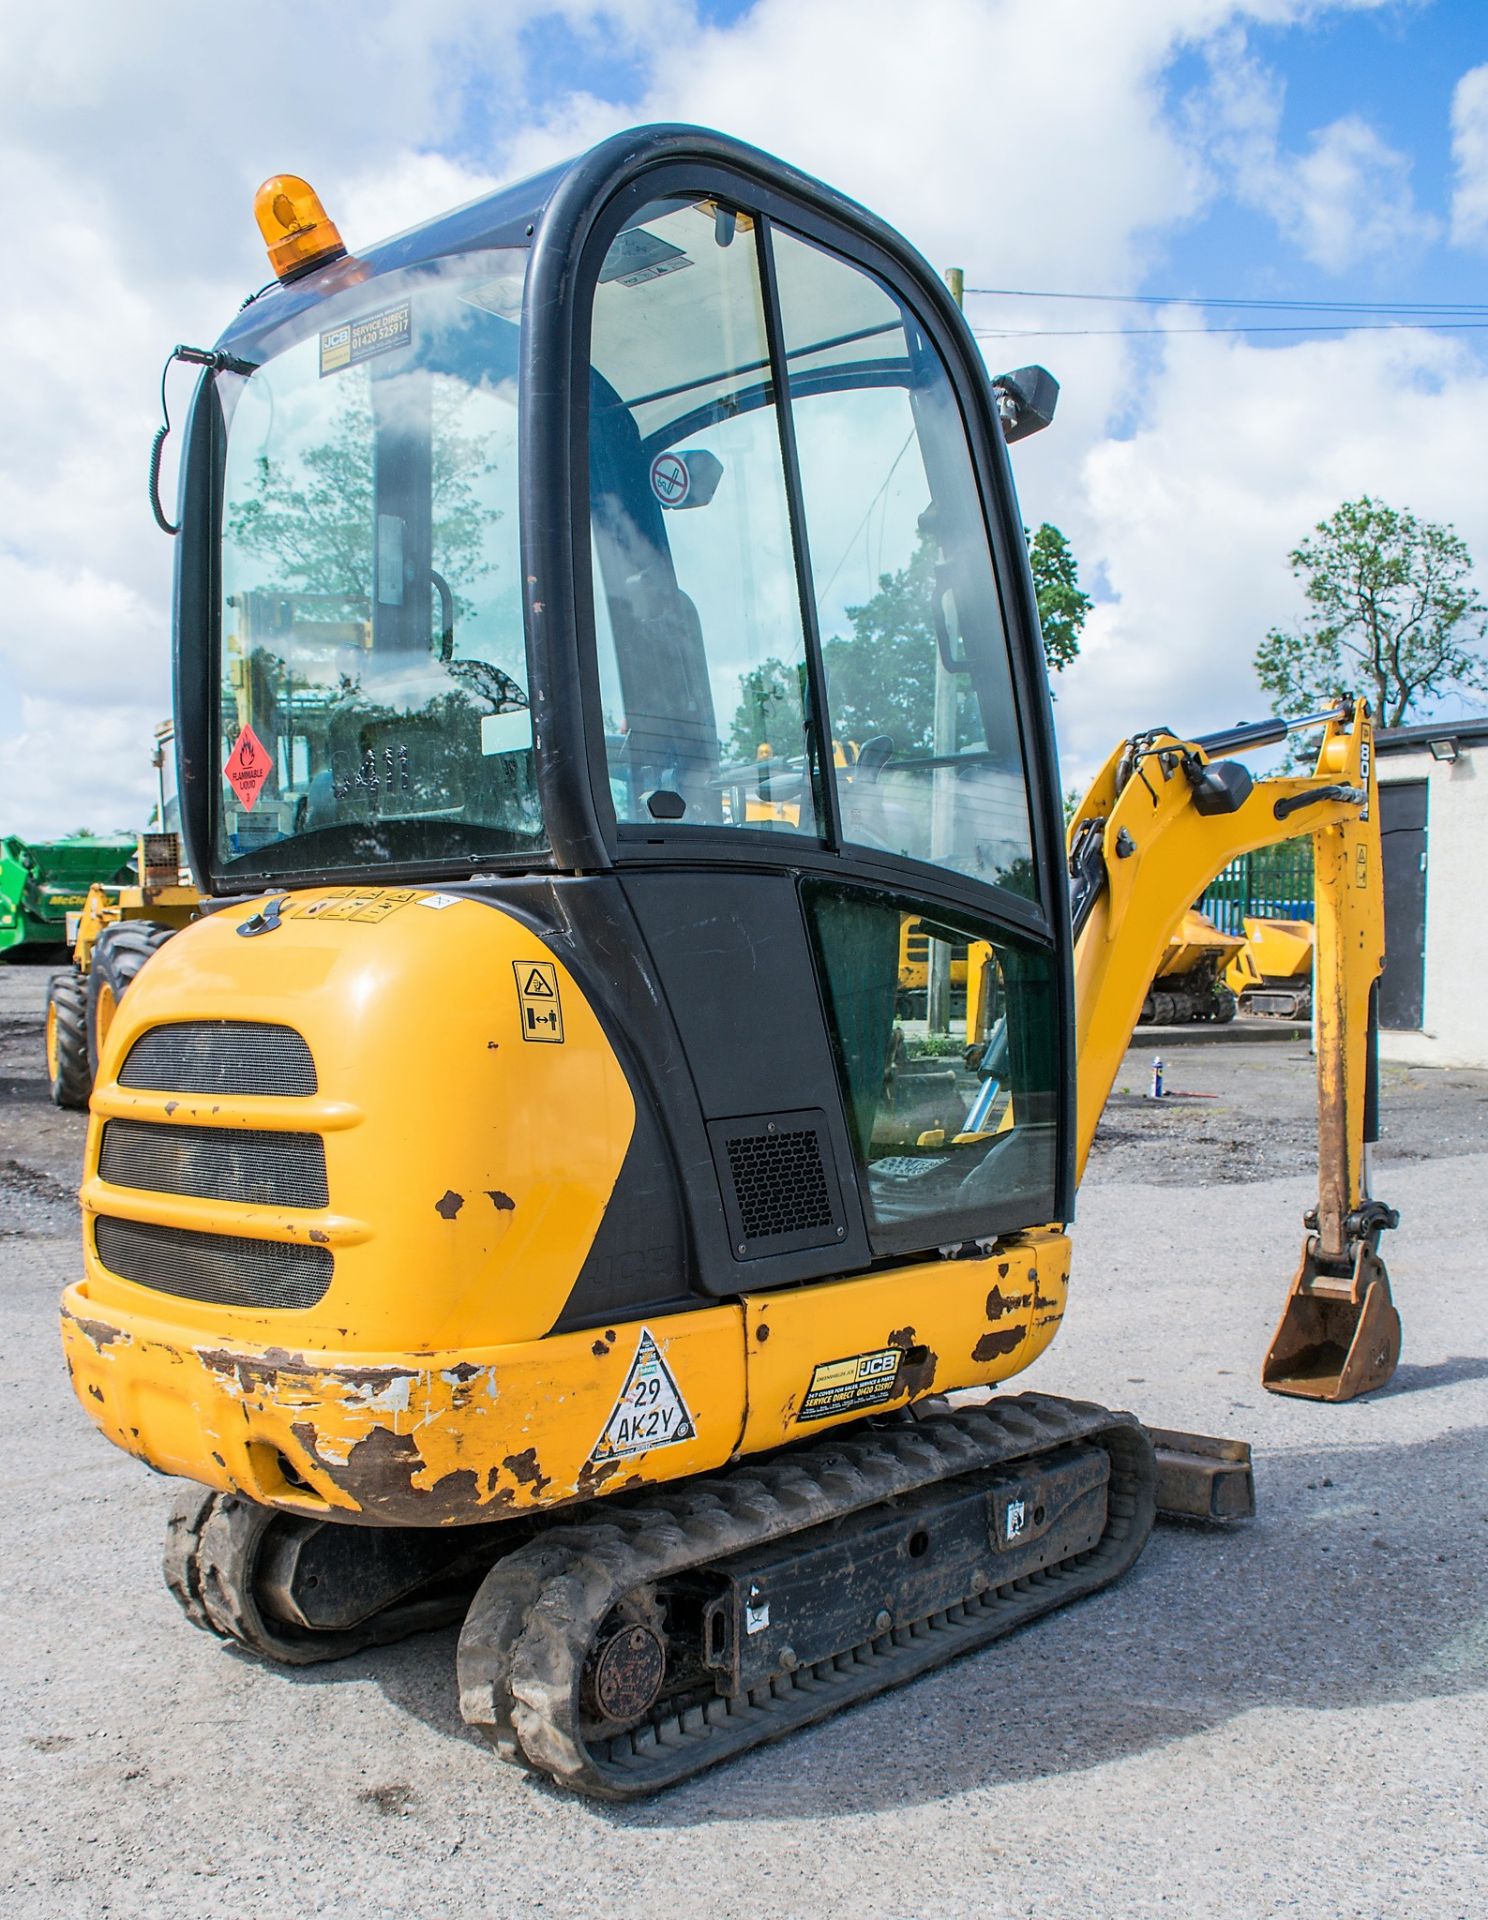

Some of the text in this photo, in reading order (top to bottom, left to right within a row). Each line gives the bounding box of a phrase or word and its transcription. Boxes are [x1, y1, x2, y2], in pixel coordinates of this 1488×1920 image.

[352, 321, 381, 338] SERVICE
[382, 309, 408, 326] DIRECT
[352, 331, 377, 349] 01420
[379, 319, 408, 340] 525917
[324, 330, 348, 348] JCB
[232, 768, 263, 781] FLAMMABLE
[240, 780, 256, 790] LIQUID
[860, 1355, 896, 1376] JCB
[634, 1378, 661, 1408] 29
[819, 1389, 834, 1397] COVER
[834, 1386, 844, 1394] FOR
[881, 1374, 896, 1383] PARTS
[805, 1395, 832, 1408] SERVICE
[833, 1390, 855, 1403] DIRECT
[616, 1407, 674, 1444] AK2Y
